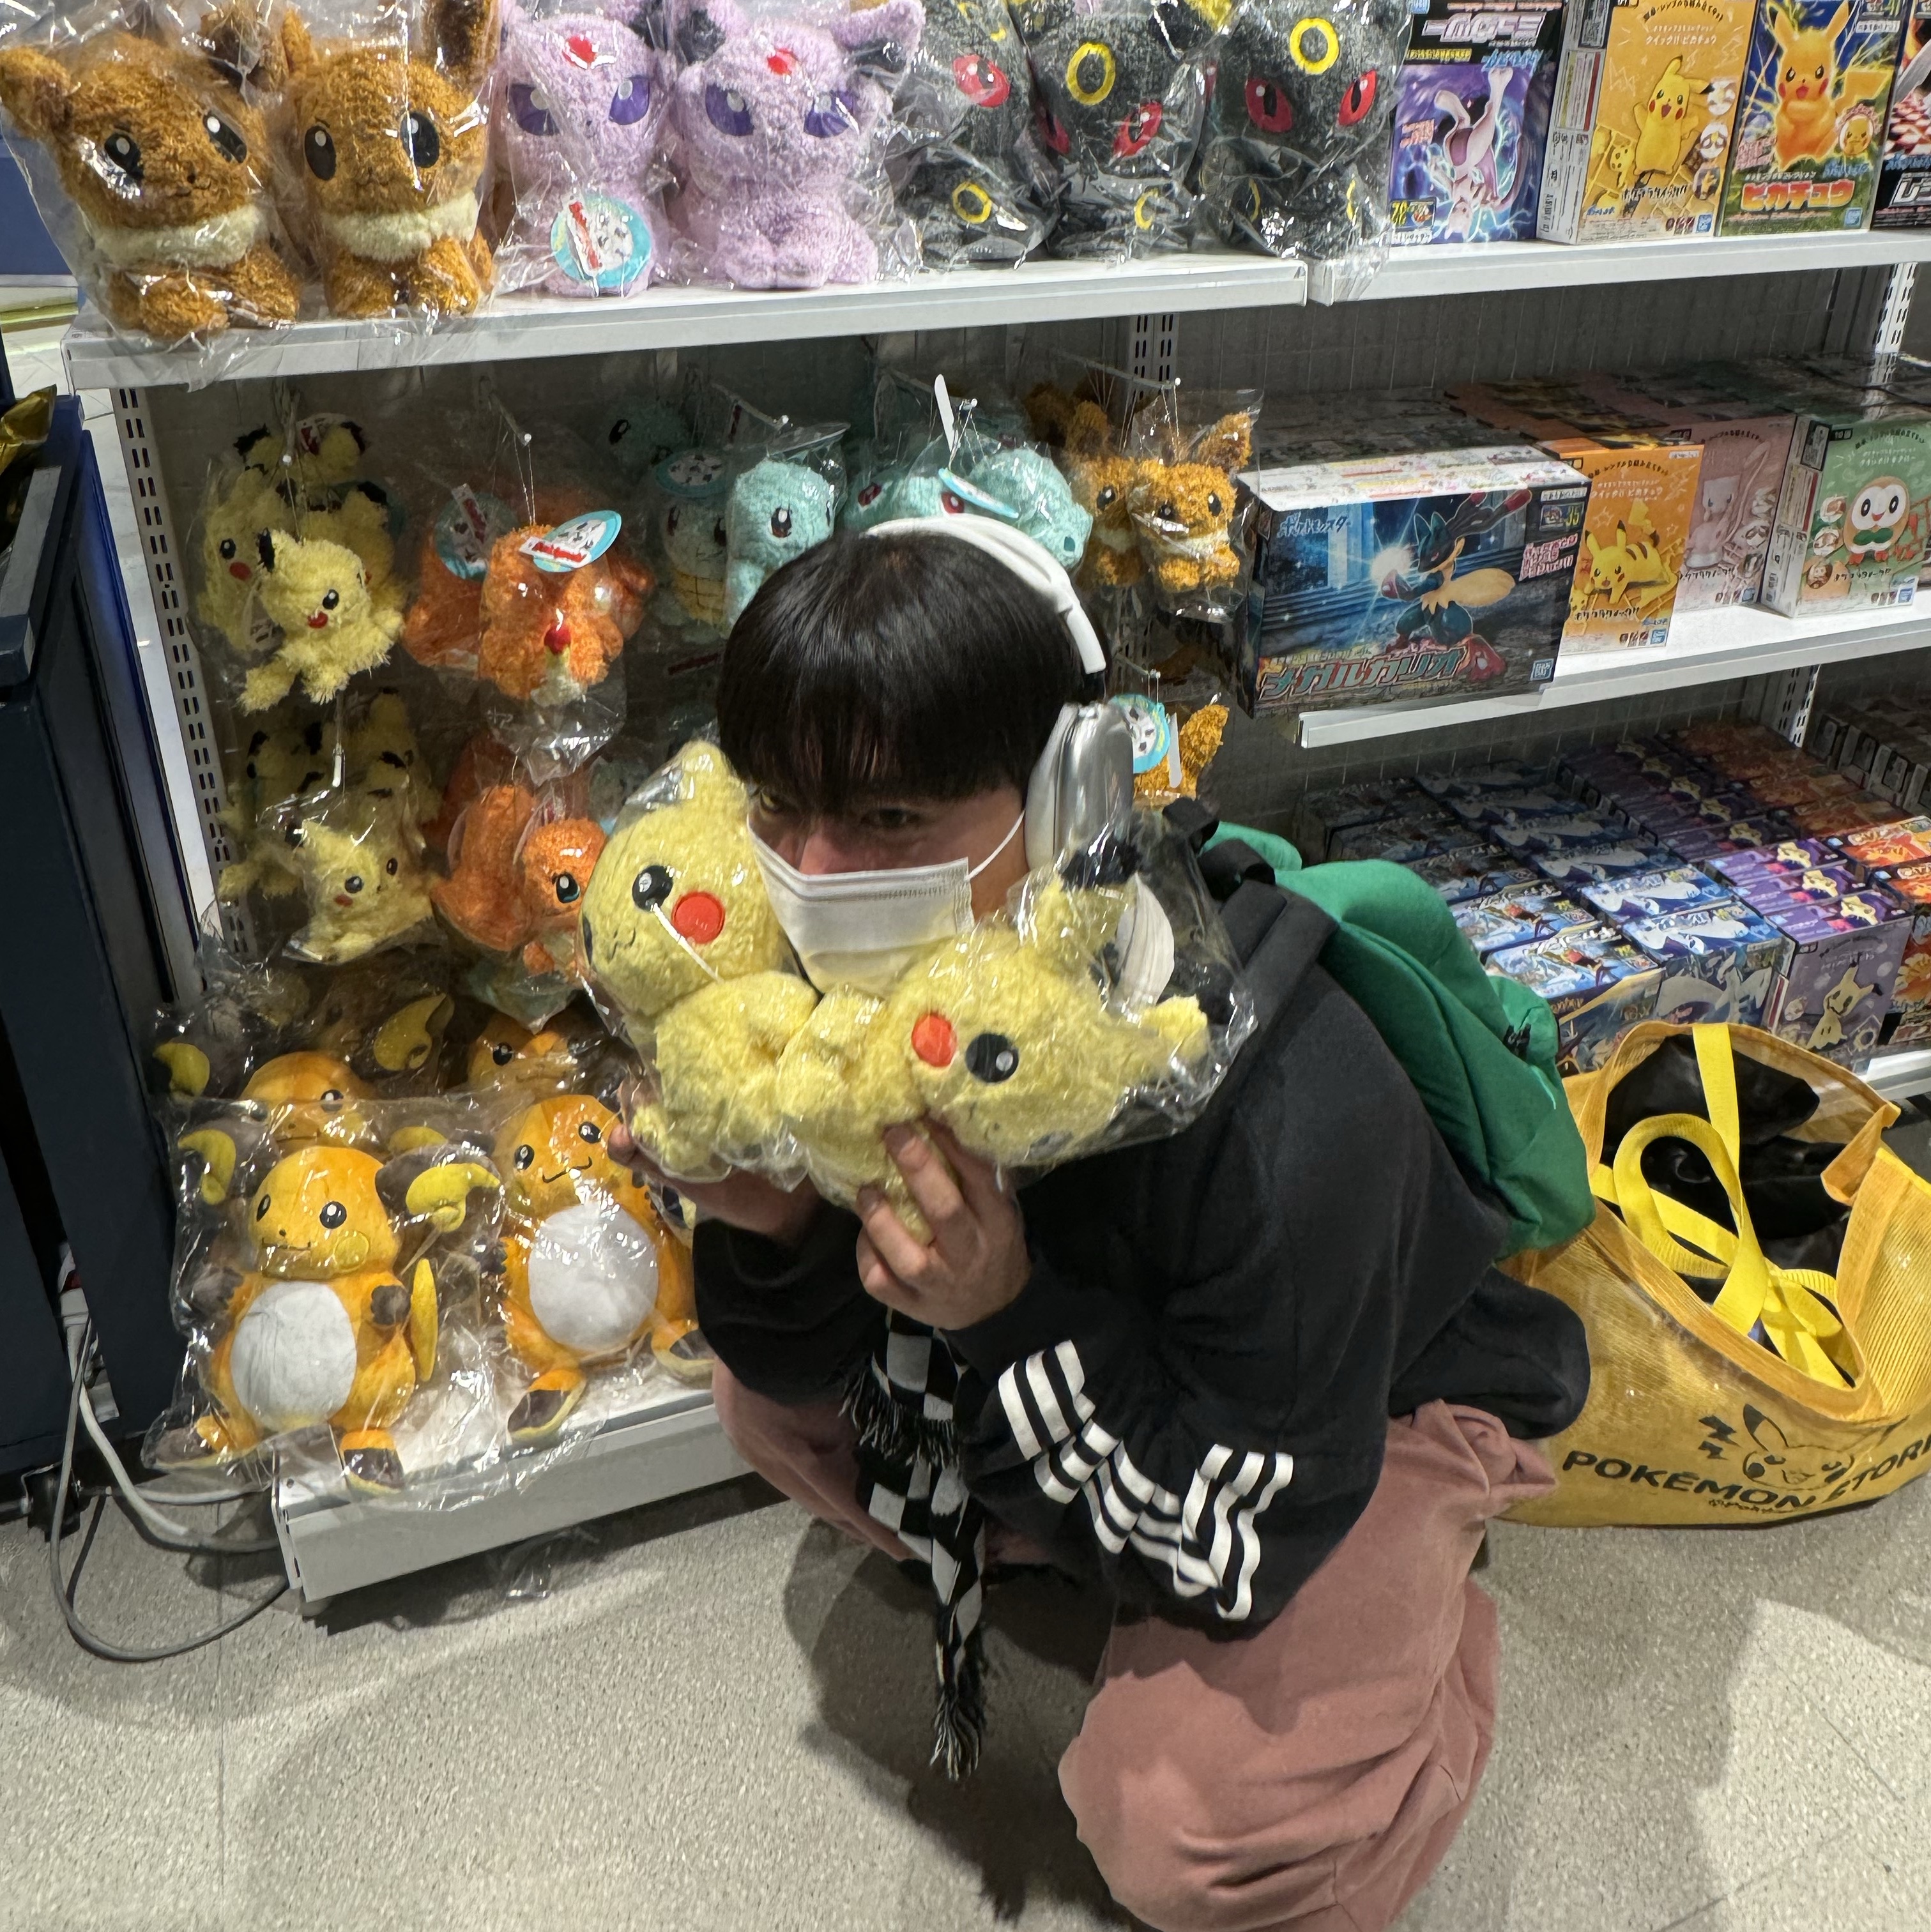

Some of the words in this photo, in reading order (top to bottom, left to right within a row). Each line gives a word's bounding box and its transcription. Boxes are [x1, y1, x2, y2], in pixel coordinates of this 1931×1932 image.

[1741, 179, 1855, 211] ピカチュウ
[1260, 647, 1467, 700] メガルカリオ
